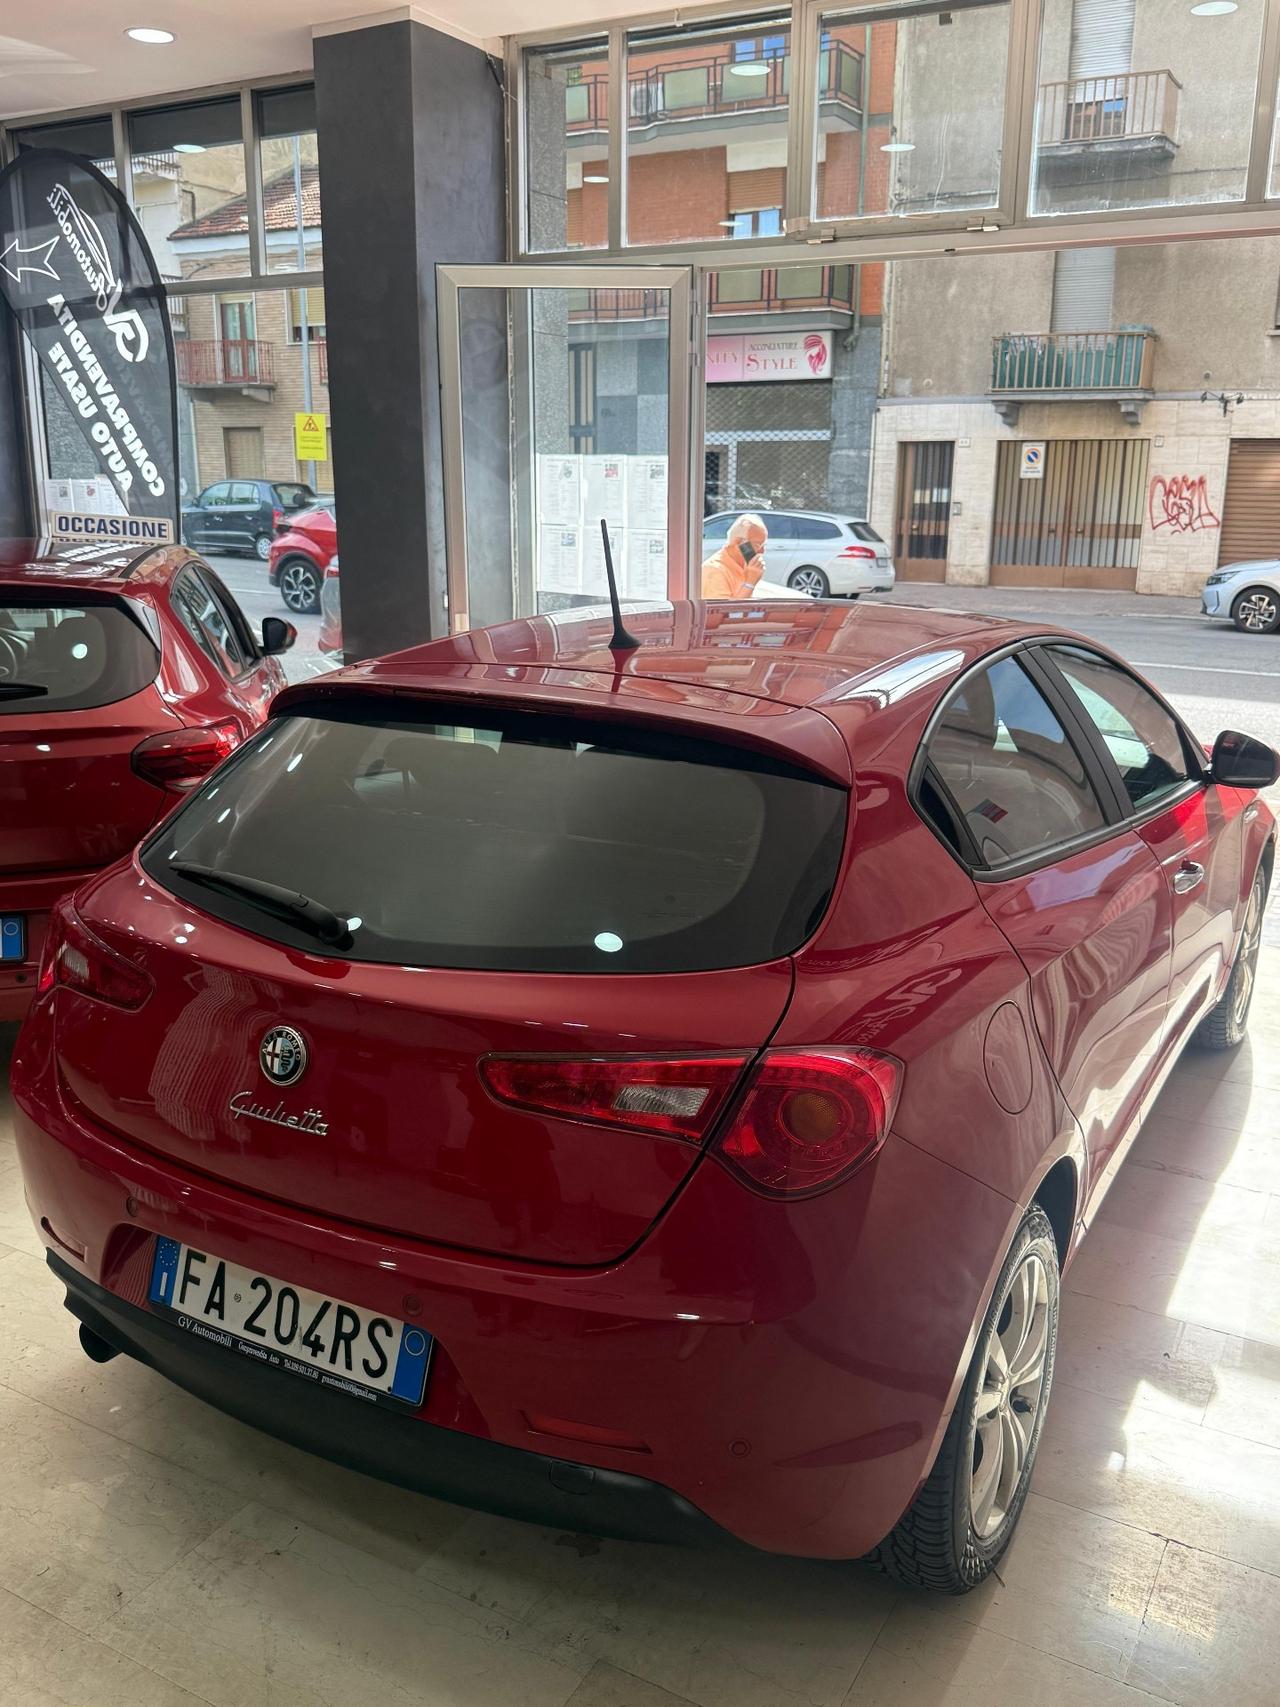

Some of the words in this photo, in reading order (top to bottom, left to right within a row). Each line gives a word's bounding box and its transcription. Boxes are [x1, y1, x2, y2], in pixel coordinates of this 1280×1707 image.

[746, 353, 798, 372] STYLE
[57, 516, 168, 538] OCCASIONE
[282, 1031, 301, 1060] ROMEO
[229, 1091, 329, 1136] Giulietta
[178, 1316, 193, 1329] GV
[192, 1323, 233, 1347] Automobili
